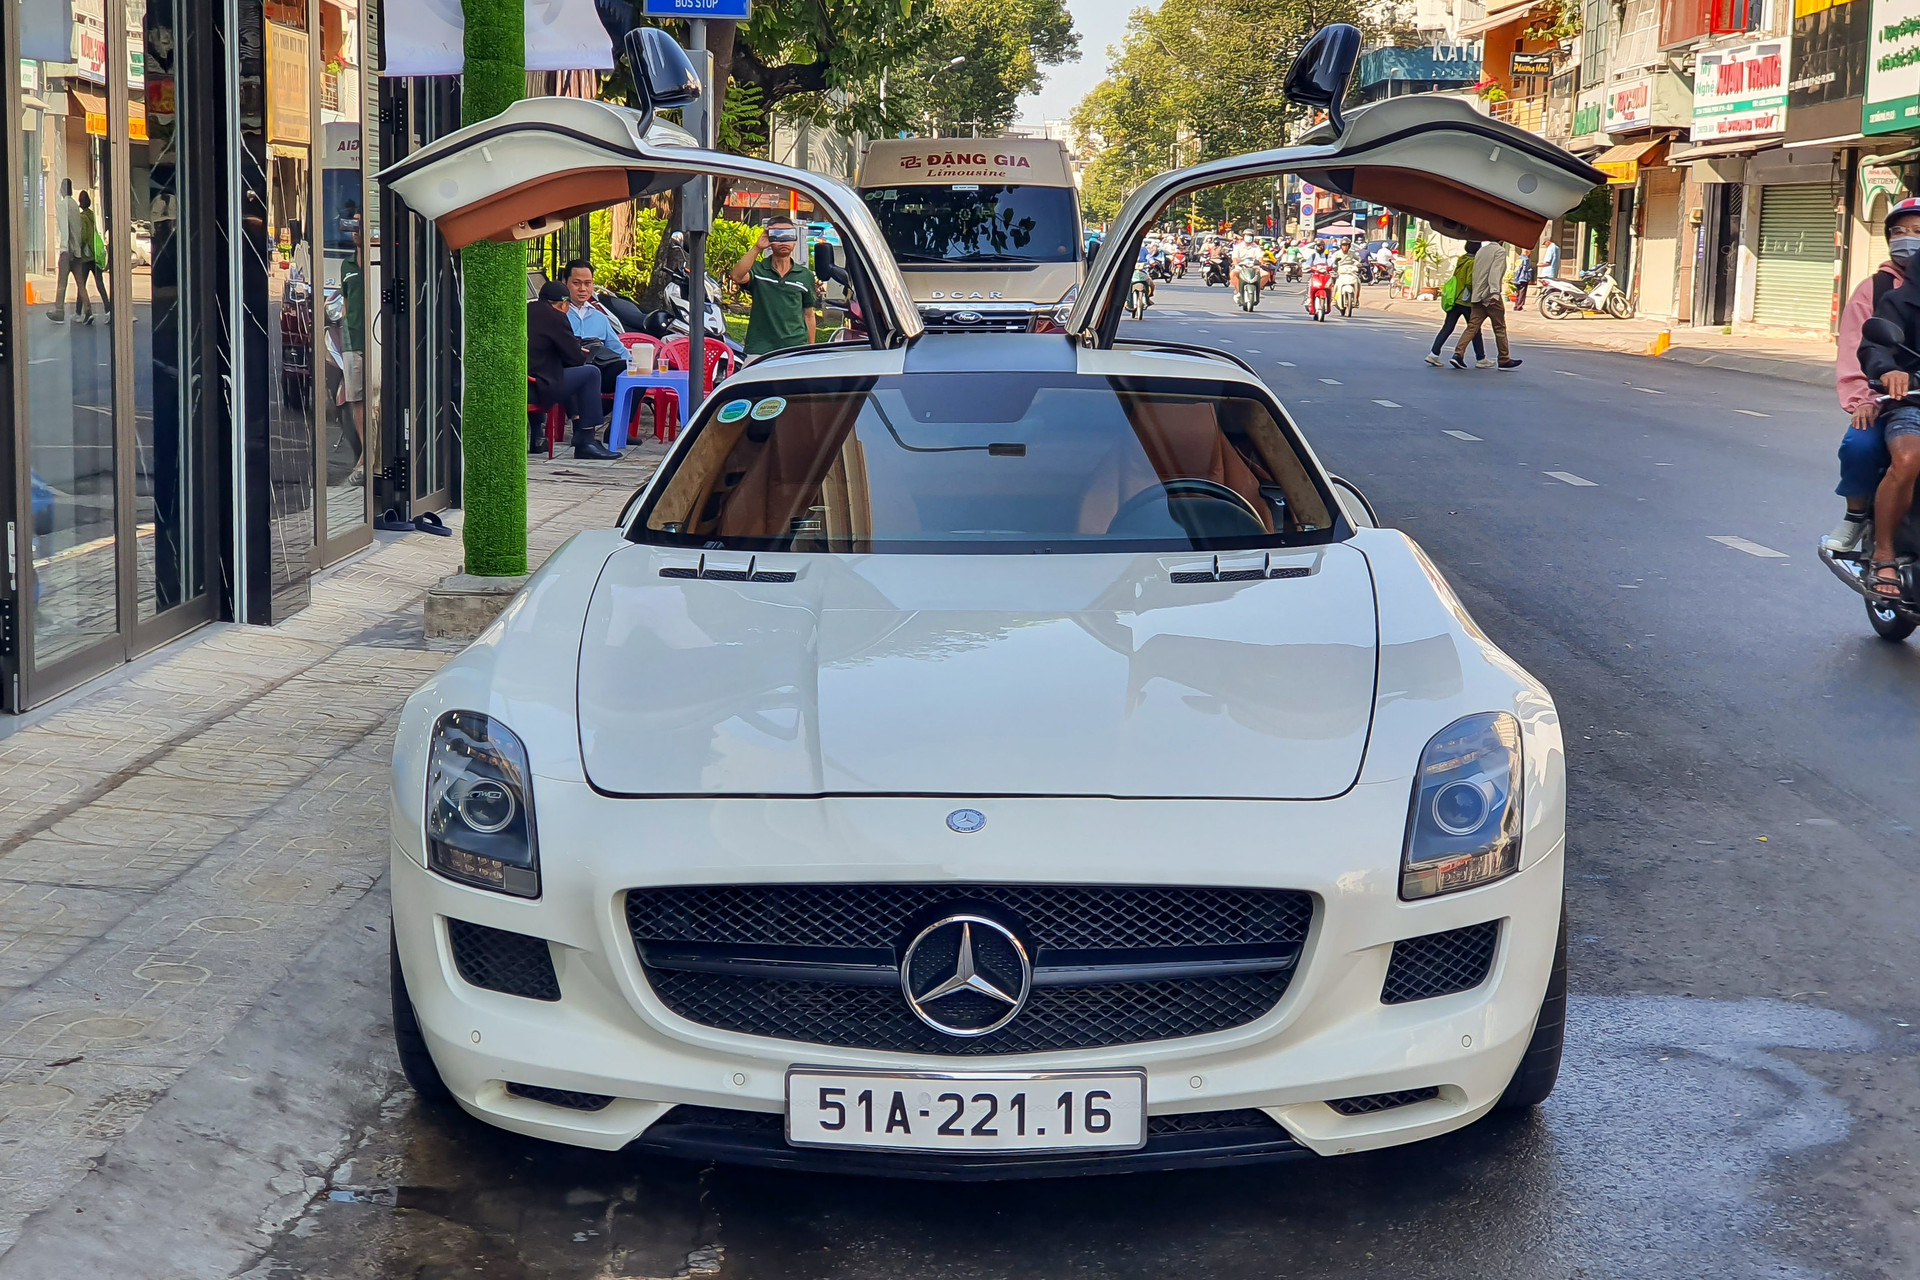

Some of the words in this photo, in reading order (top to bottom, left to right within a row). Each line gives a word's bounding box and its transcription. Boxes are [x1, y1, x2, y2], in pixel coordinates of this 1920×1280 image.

[675, 0, 693, 8] BUS
[695, 0, 719, 9] STOP
[1745, 53, 1782, 92] TRANG
[926, 151, 987, 168] ĐẶNG
[993, 154, 1030, 168] GIA
[926, 168, 1006, 177] Limousine
[931, 290, 1003, 299] DCAR
[958, 313, 977, 322] Ford
[818, 1086, 1112, 1137] 51A-221.16
